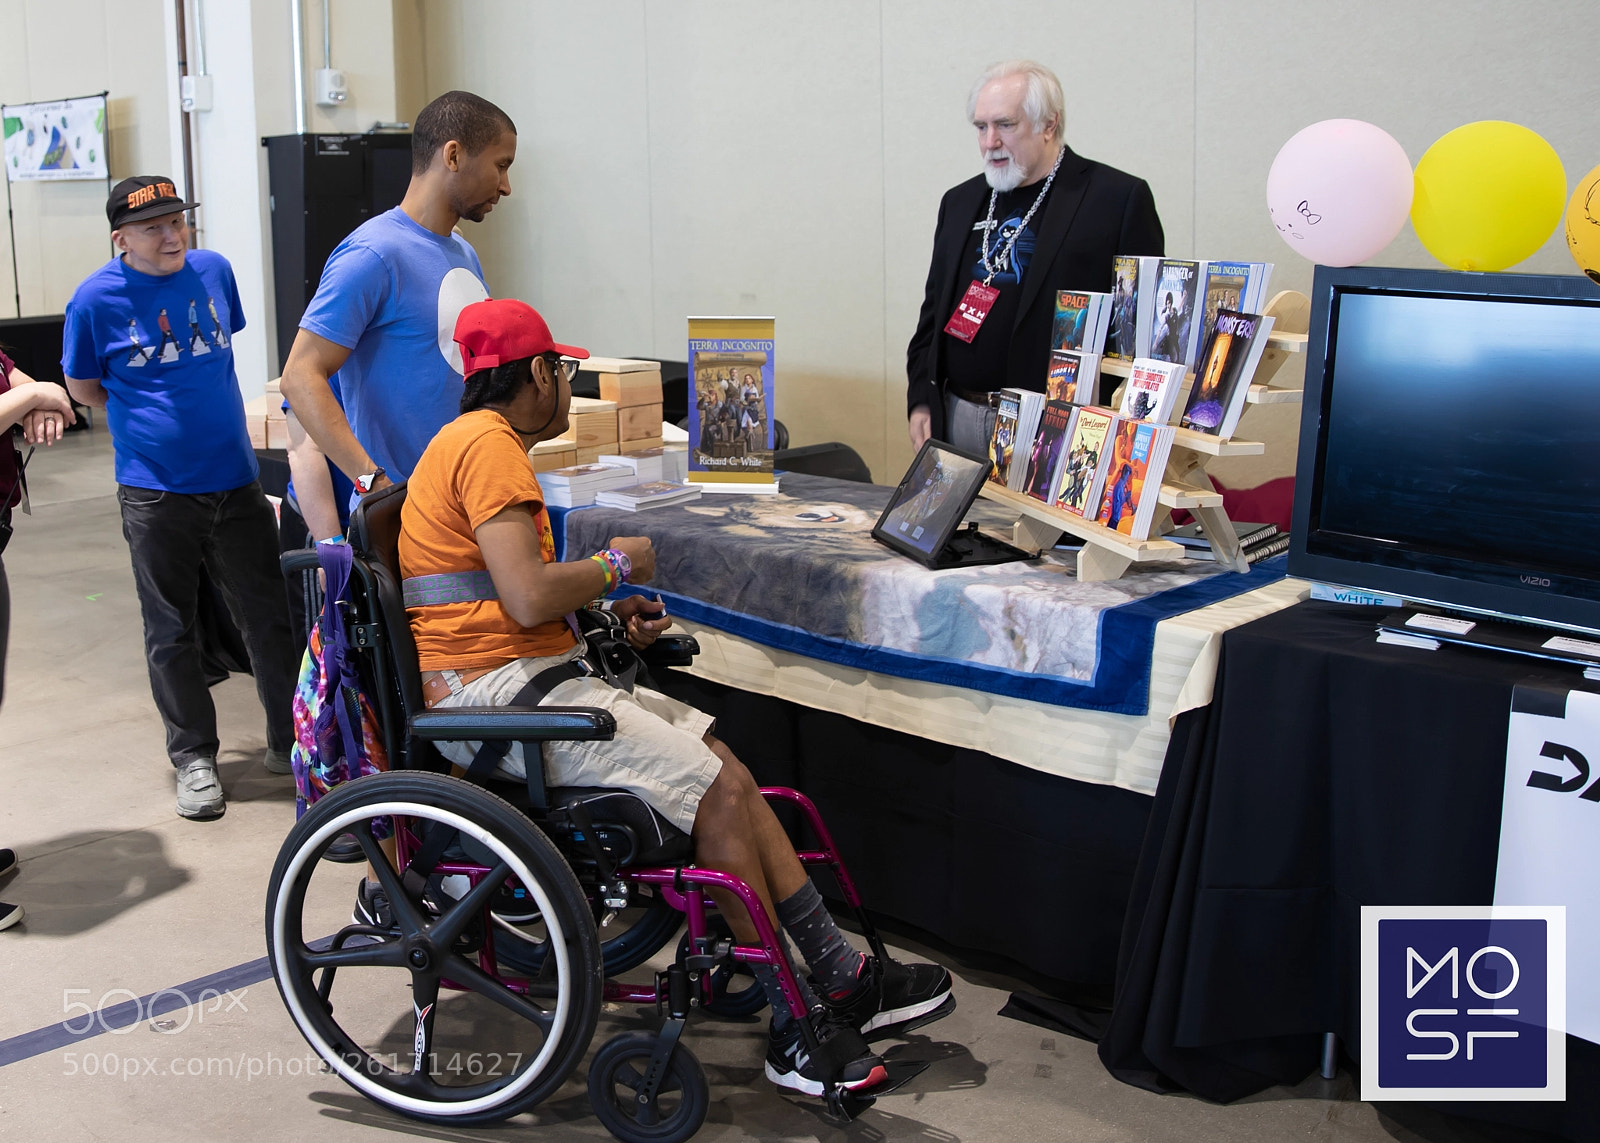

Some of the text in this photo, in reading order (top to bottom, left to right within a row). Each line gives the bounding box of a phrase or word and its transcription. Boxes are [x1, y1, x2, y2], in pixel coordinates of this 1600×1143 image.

[127, 182, 177, 209] STAR TRE
[1207, 265, 1250, 276] TERRA INCOGNITO
[690, 340, 773, 351] TERRA INCOGNITO
[699, 455, 762, 467] Richard C. White
[1520, 574, 1551, 587] VIZIO
[1334, 592, 1384, 606] WHITE
